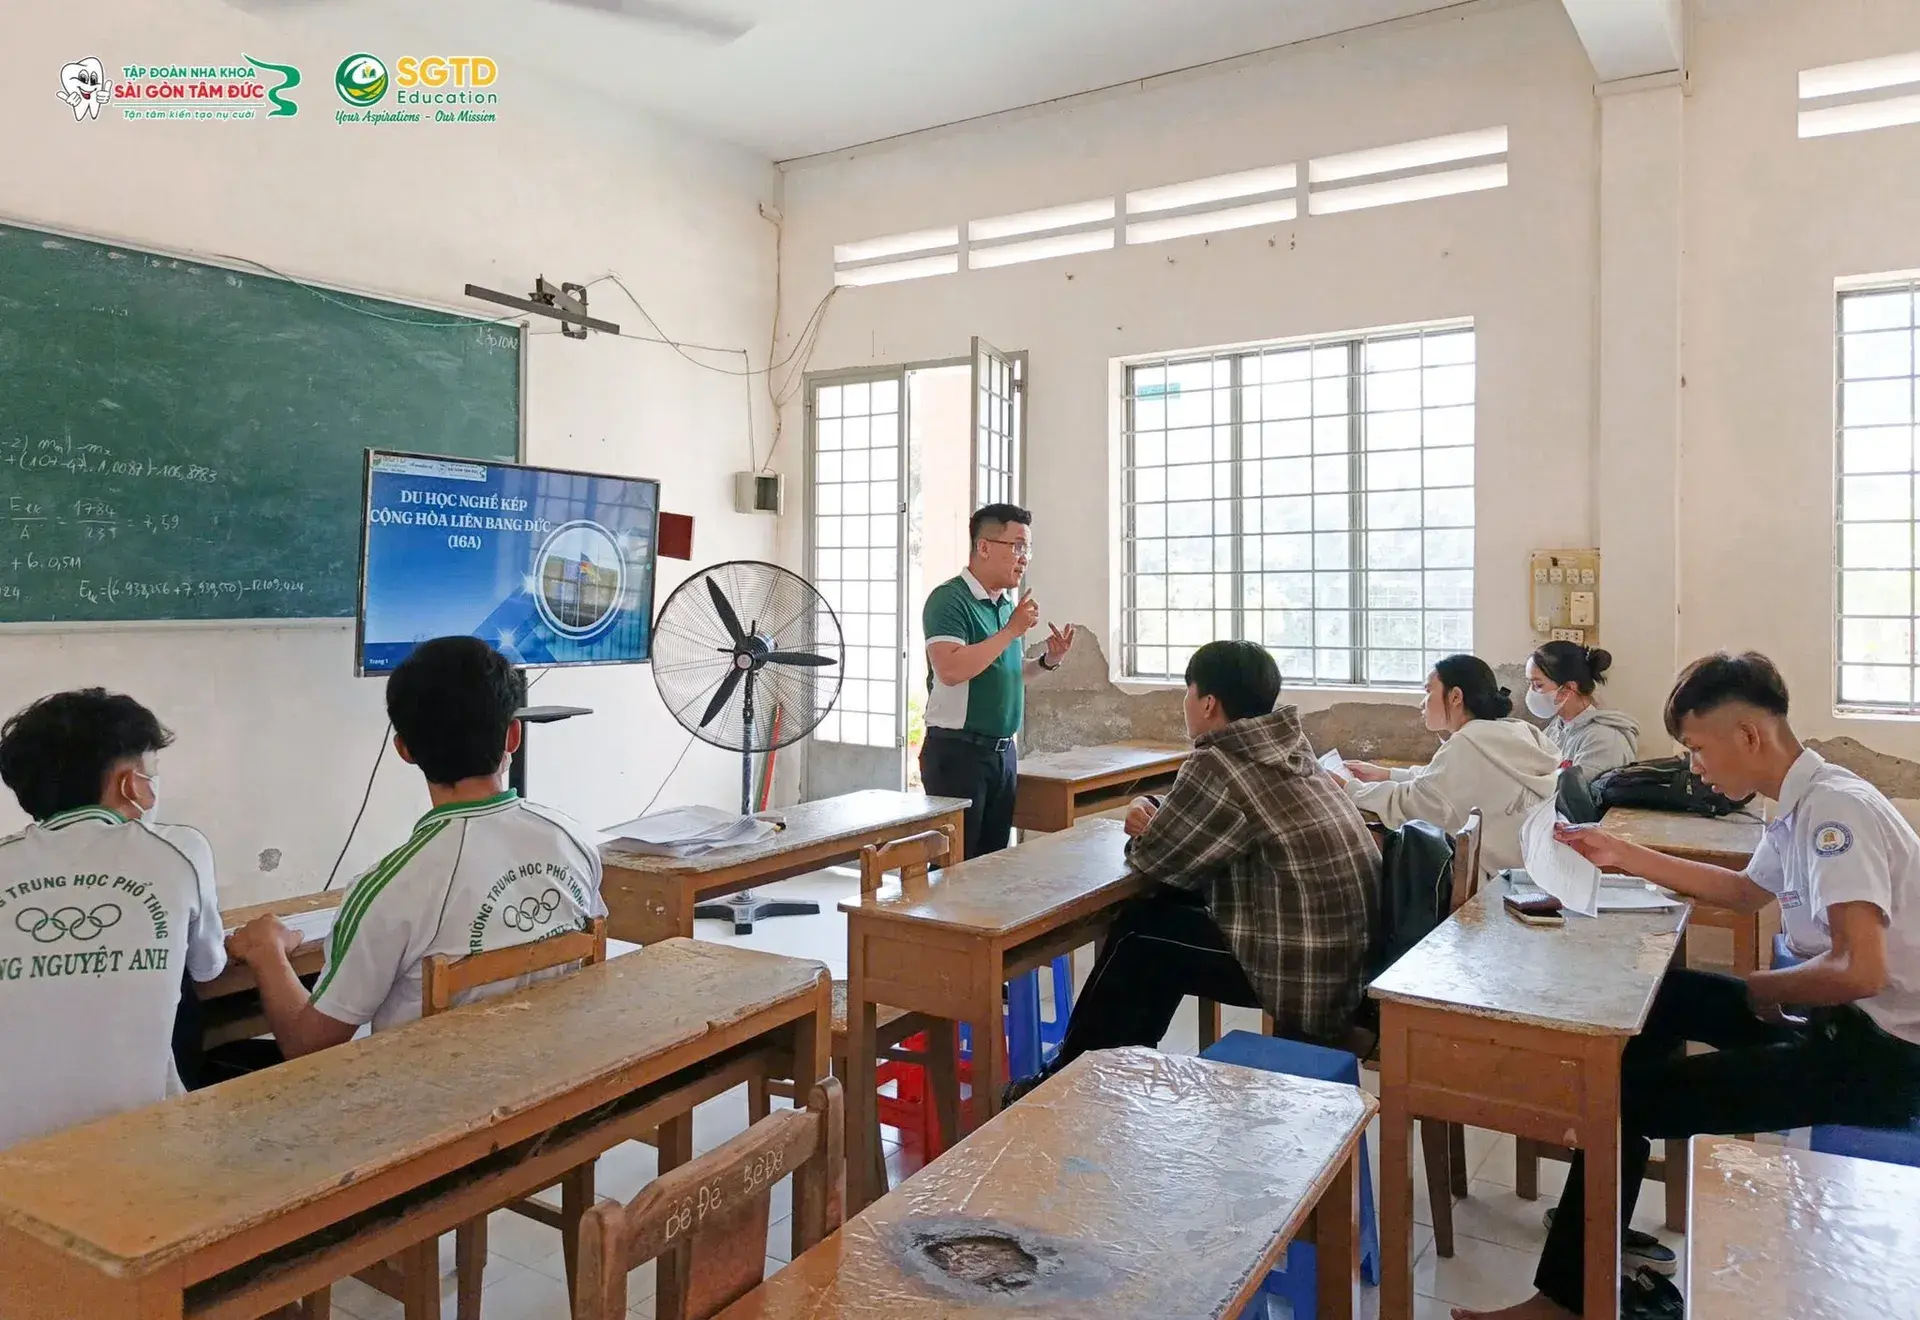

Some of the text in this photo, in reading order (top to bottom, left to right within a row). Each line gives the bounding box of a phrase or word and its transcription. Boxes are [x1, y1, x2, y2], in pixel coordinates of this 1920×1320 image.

[400, 490, 527, 511] DU HỌC NGHỀ KÉP
[370, 507, 551, 532] CỘNG HÒA LIÊN BANG ĐỨC
[447, 535, 481, 550] (16A)
[487, 869, 517, 902] TRUNG
[518, 862, 542, 878] HỌC
[546, 863, 570, 881] PHỔ
[6, 874, 168, 939] TRUNG HỌC PHỔ THÔNG
[30, 945, 123, 978] NGUYỆT
[128, 948, 168, 970] ANH
